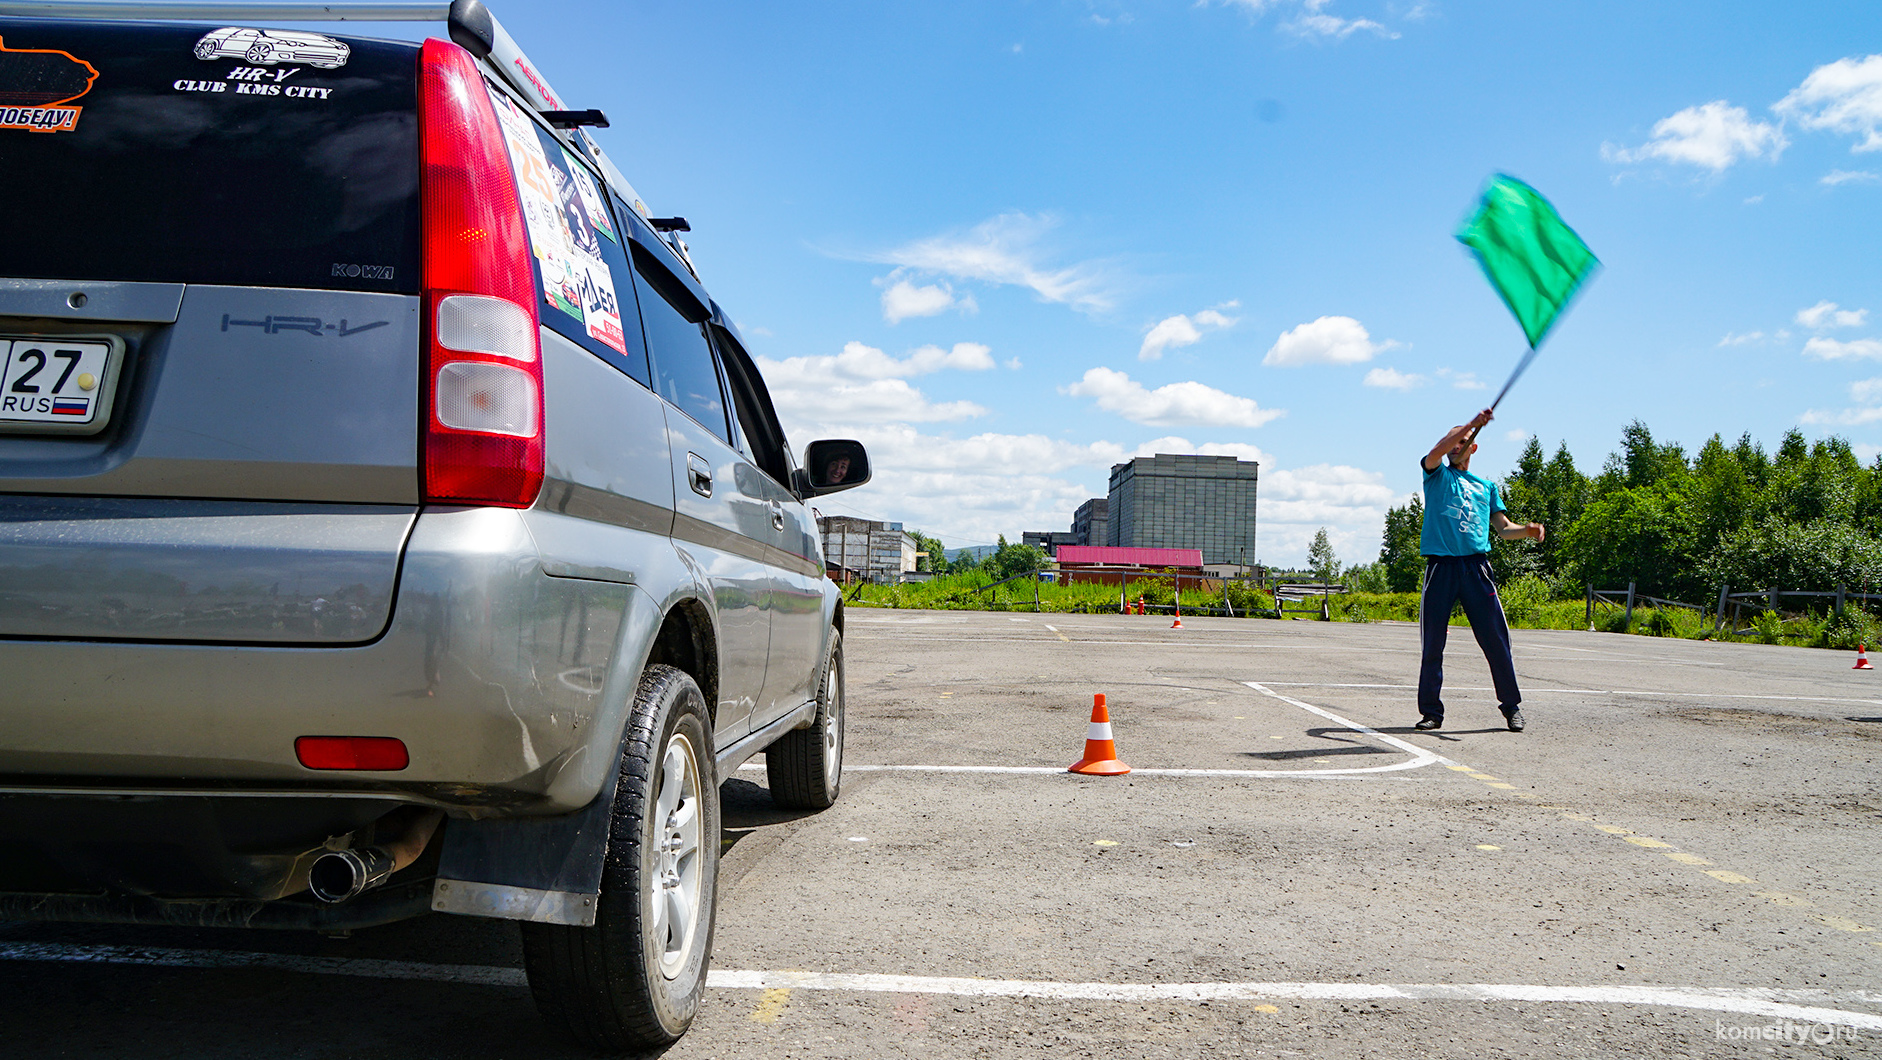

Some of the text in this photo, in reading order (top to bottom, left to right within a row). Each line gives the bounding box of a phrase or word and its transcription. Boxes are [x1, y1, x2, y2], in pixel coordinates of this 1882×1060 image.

[226, 66, 301, 83] HR-V
[514, 57, 563, 111] AEROR
[173, 79, 333, 100] CLUB KMS CITY
[512, 139, 554, 203] 25
[571, 165, 593, 198] 15
[569, 203, 590, 247] 3
[331, 263, 395, 280] KOWA
[221, 313, 390, 337] HR-V
[11, 348, 83, 394] 27
[2, 396, 51, 413] RUS
